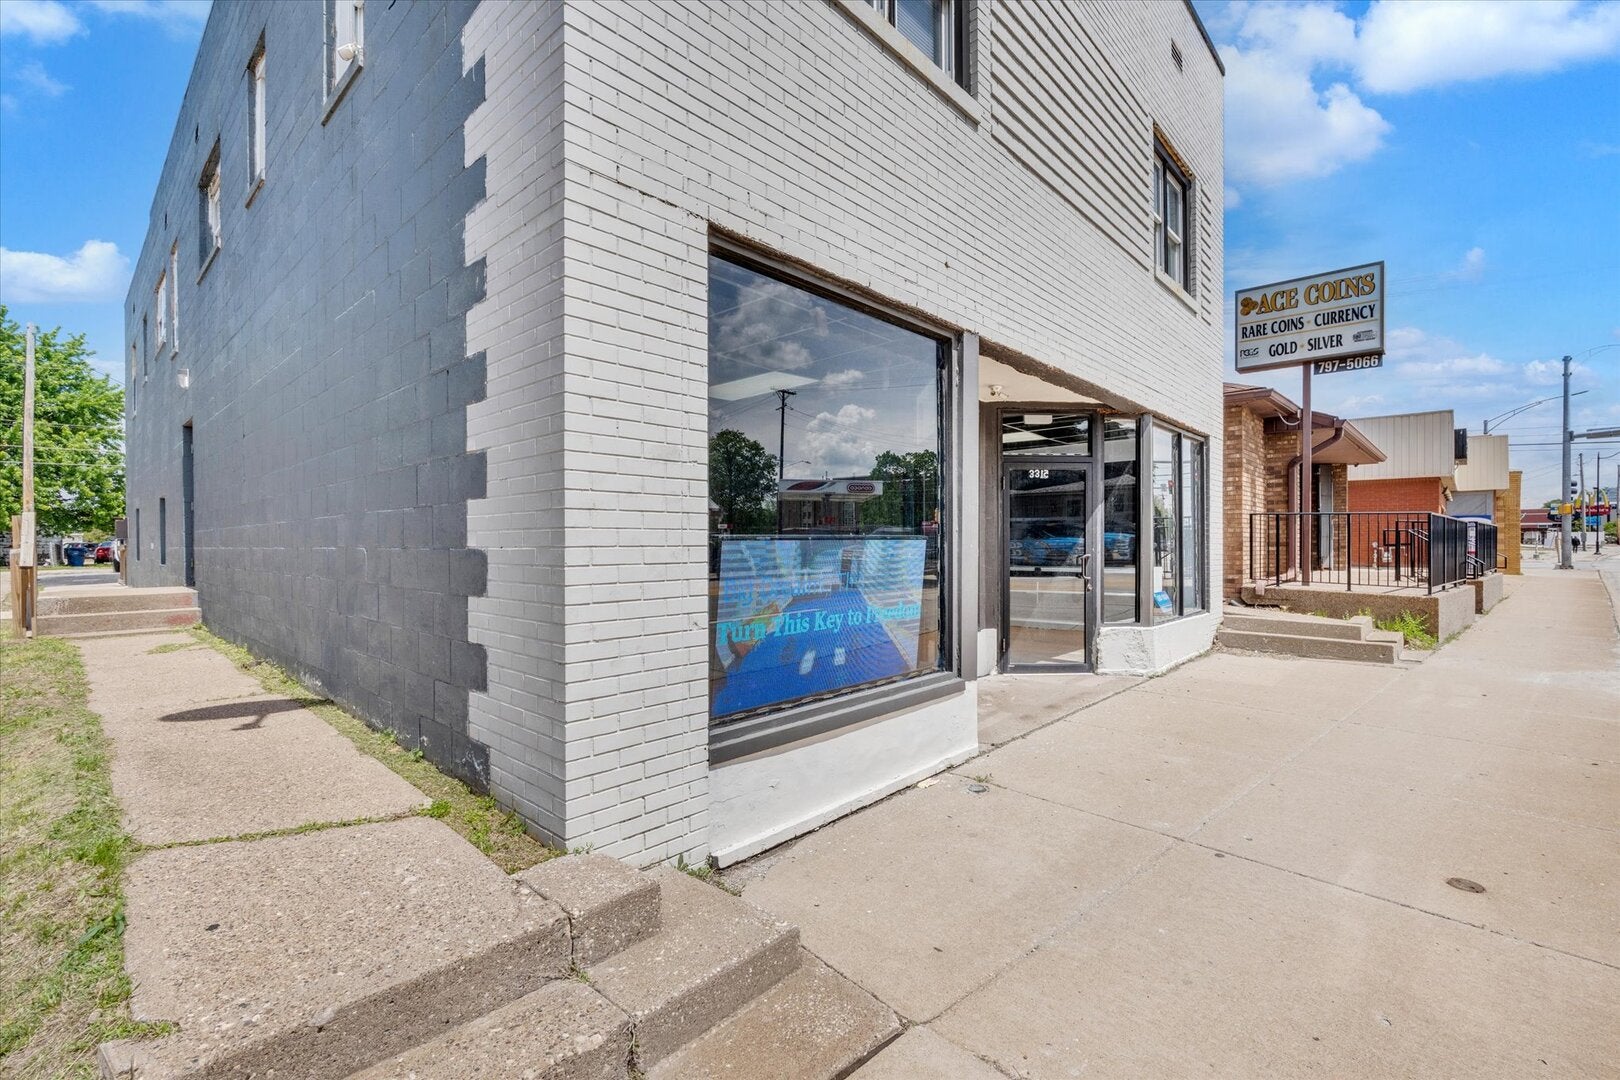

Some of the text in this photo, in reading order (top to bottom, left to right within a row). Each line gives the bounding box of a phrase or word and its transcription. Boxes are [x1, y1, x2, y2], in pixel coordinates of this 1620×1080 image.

[1256, 272, 1376, 315] ACE COINS
[1241, 304, 1376, 340] RARE COINS CURRENCY
[1269, 341, 1298, 357] GOLD
[1307, 334, 1343, 352] SILVER
[1318, 355, 1379, 374] 797-5066
[717, 621, 767, 646] Turn
[769, 612, 811, 637] This
[813, 609, 844, 634] Key
[849, 608, 862, 626] to
